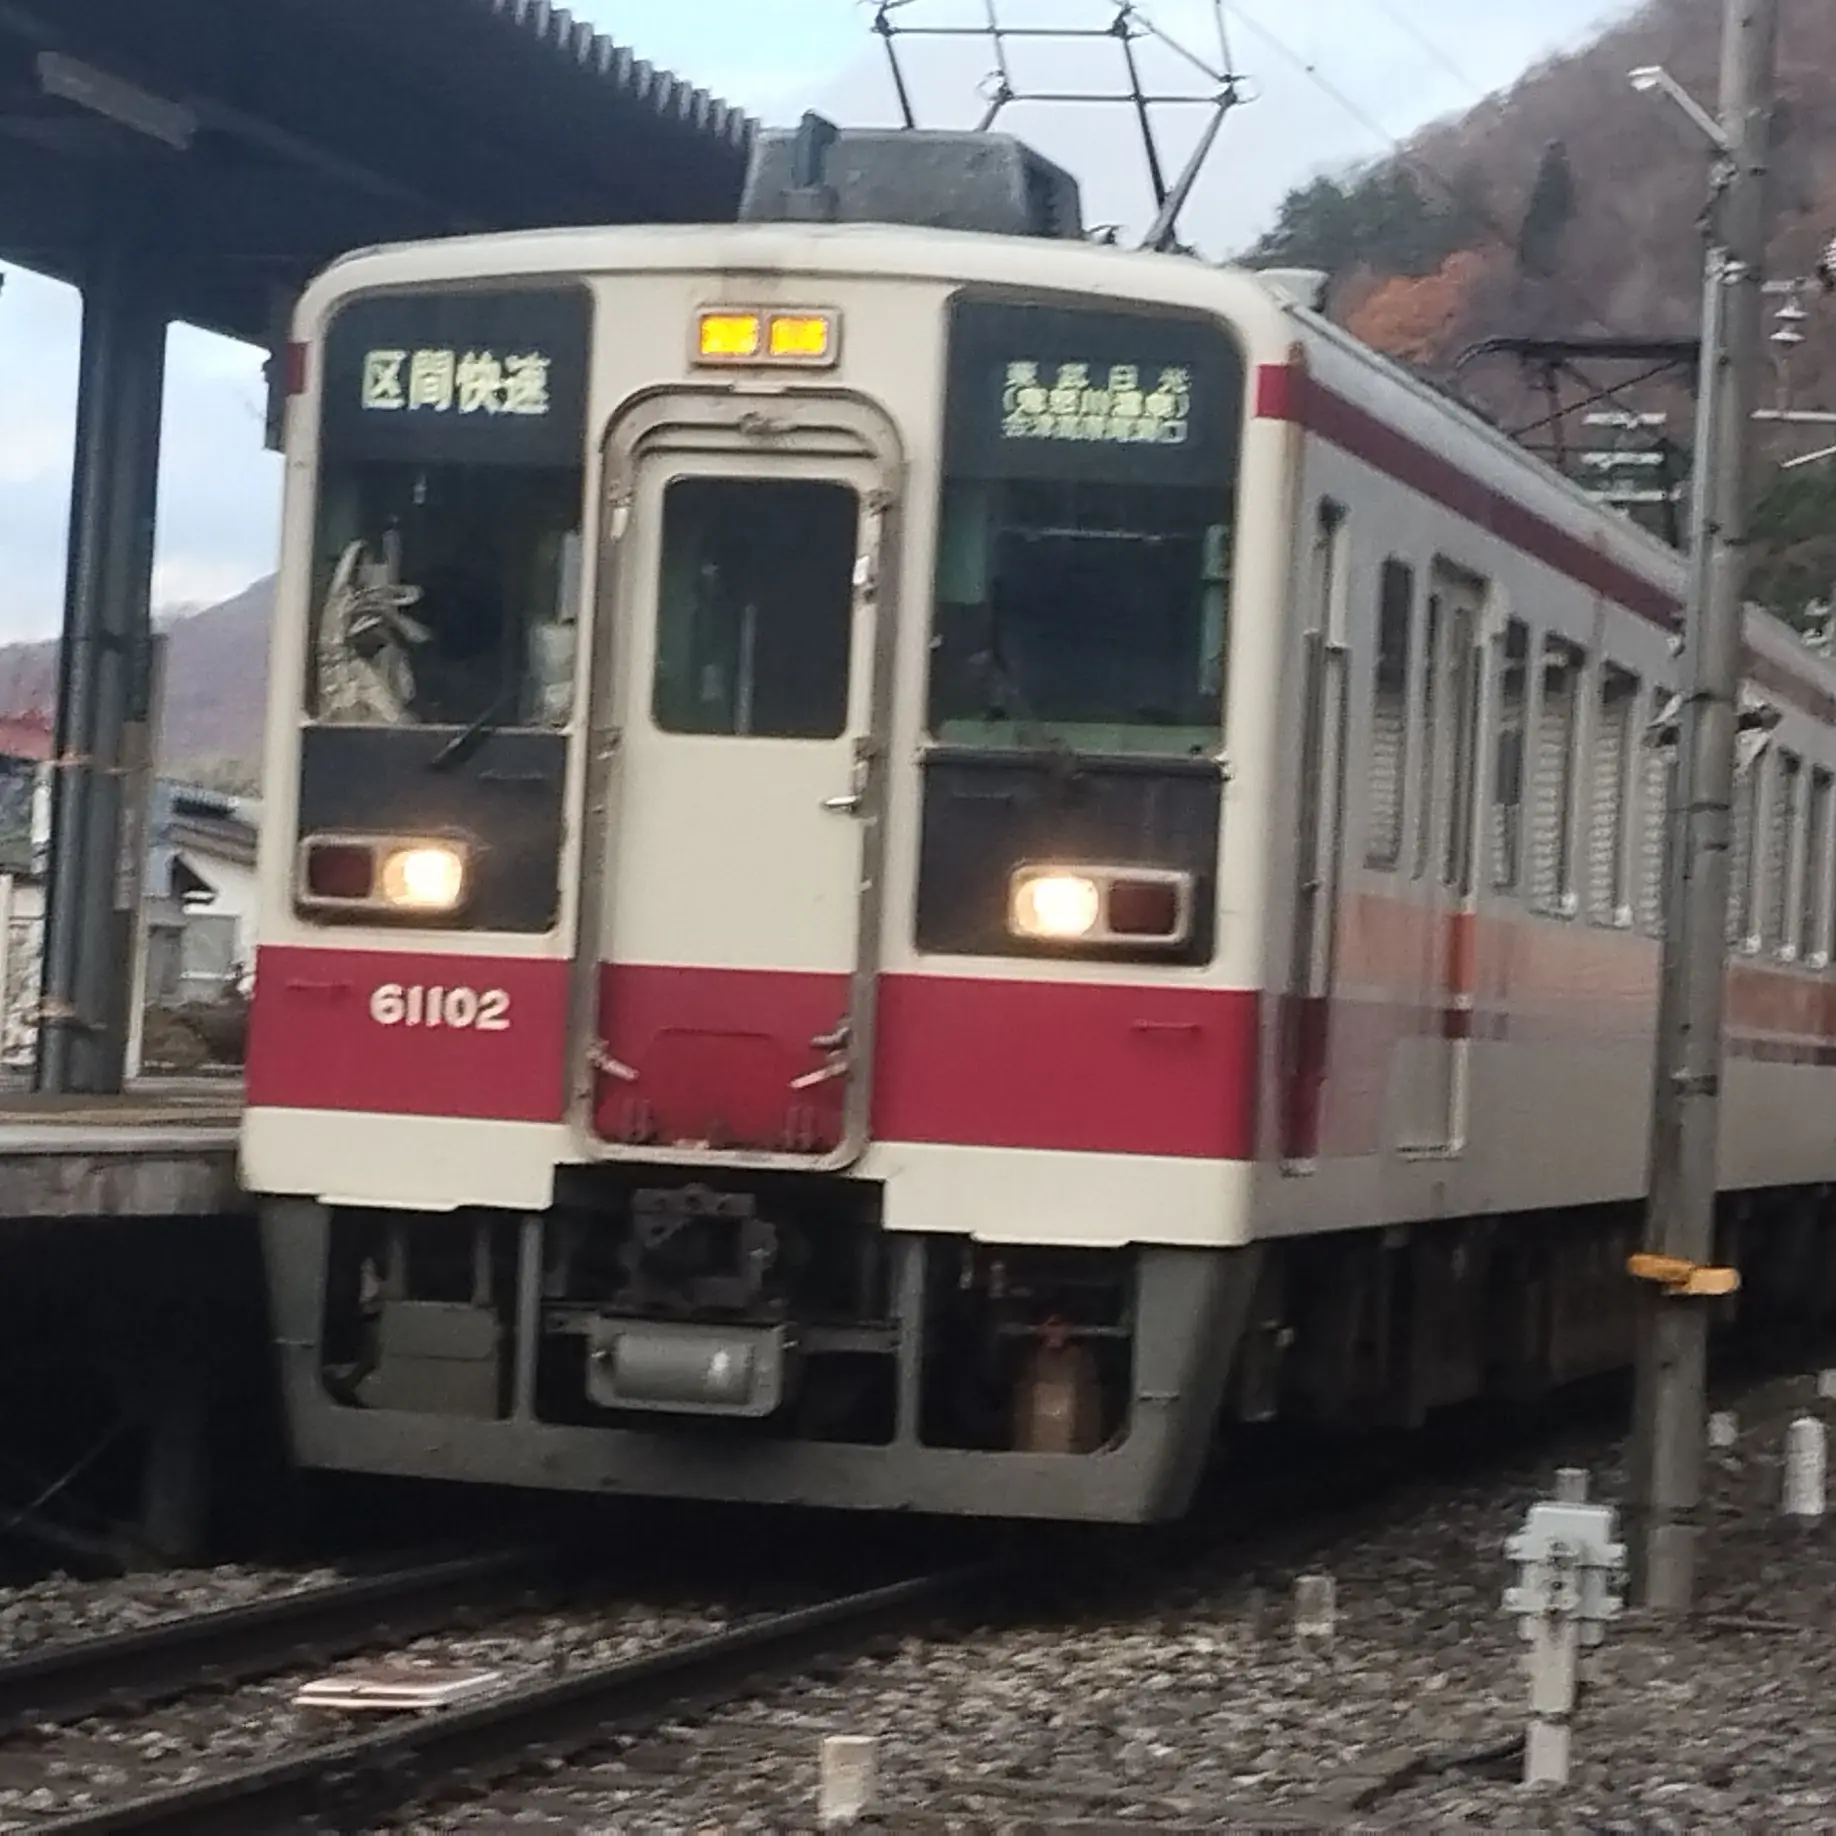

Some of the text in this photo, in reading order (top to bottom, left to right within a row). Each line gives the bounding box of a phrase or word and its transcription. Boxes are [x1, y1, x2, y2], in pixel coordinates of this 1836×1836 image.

[362, 349, 550, 414] 区間快速
[370, 983, 510, 1030] 61102
